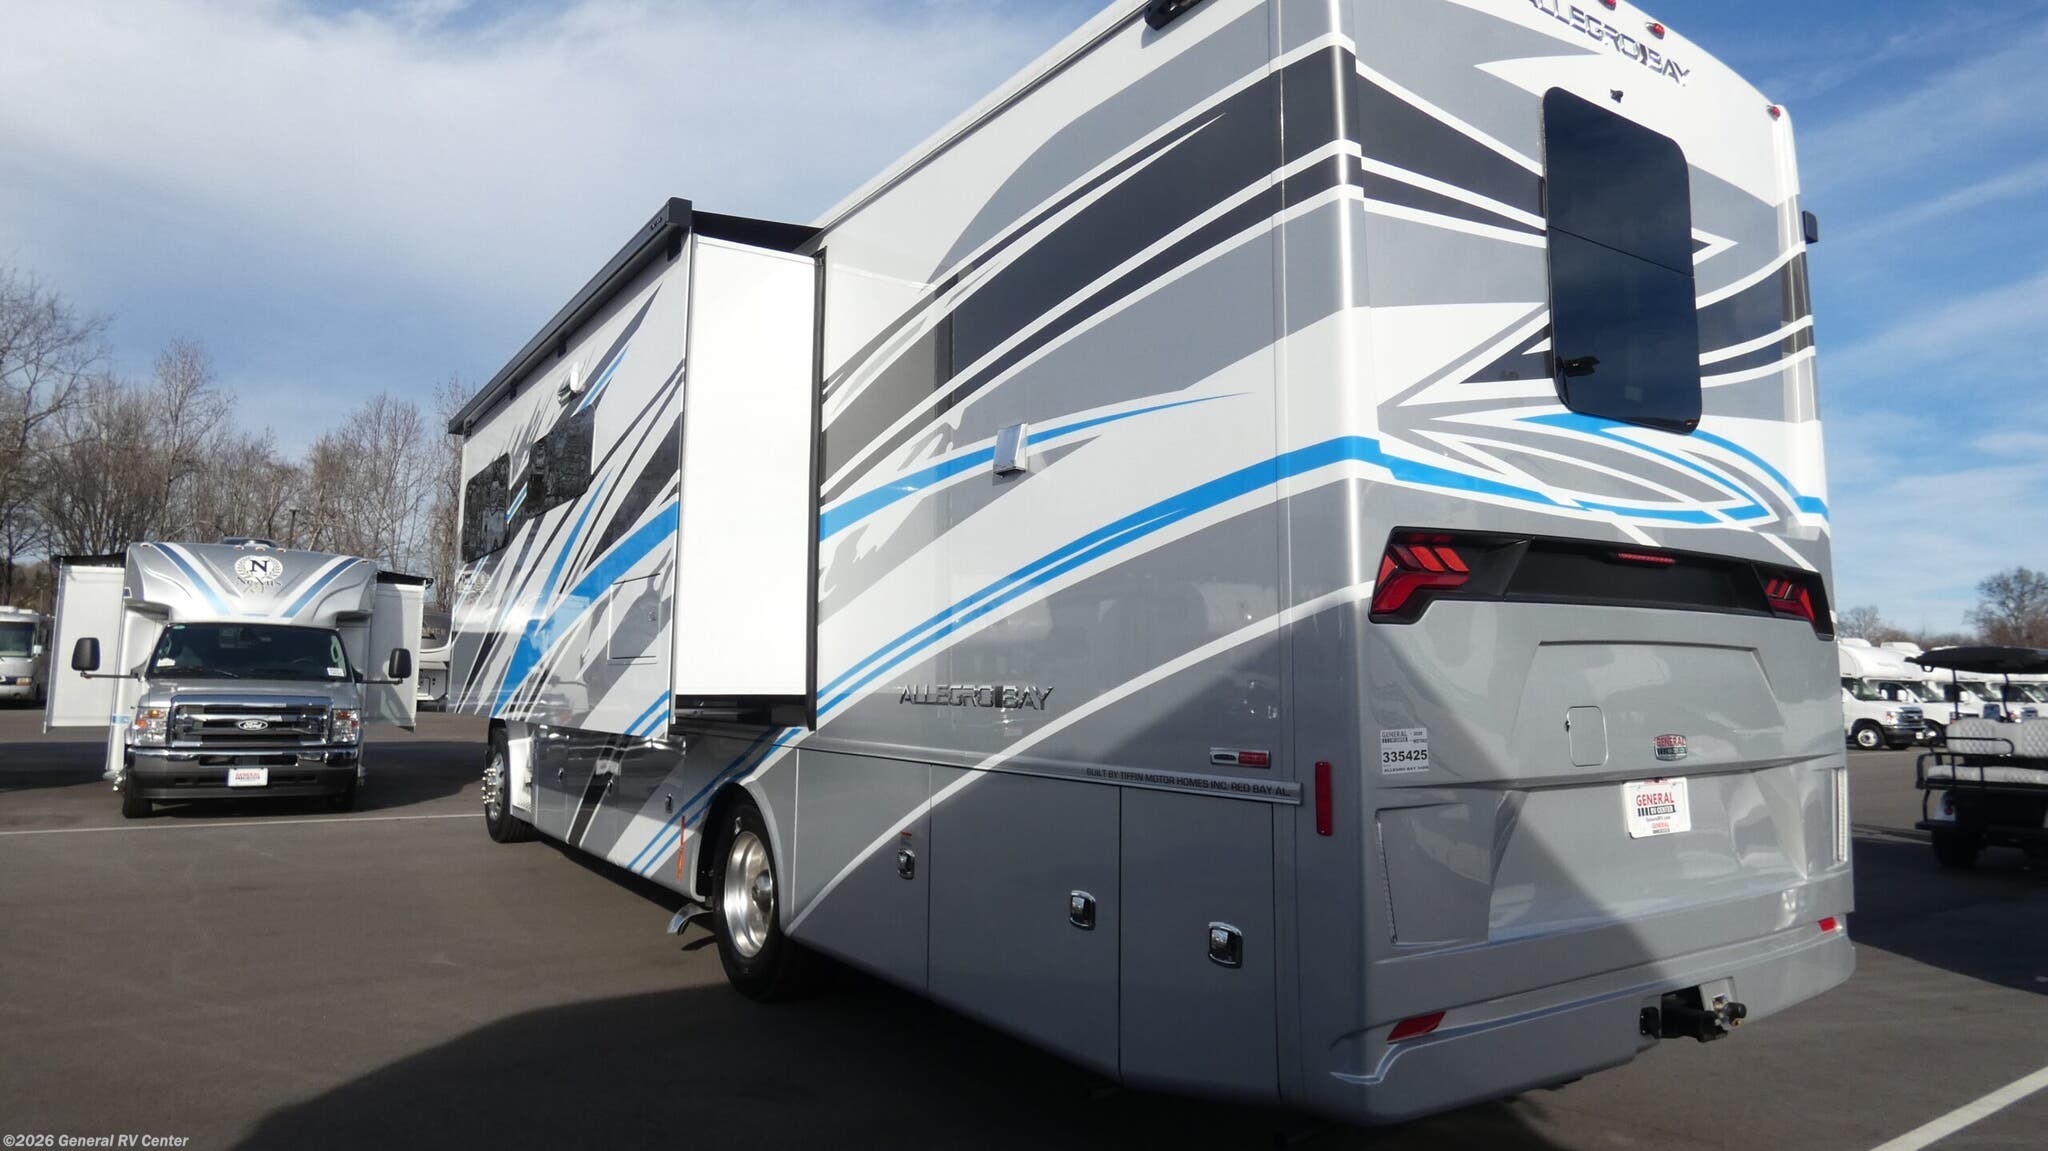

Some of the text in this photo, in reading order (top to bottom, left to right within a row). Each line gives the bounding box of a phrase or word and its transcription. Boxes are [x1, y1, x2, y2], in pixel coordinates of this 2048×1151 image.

[1647, 47, 1691, 84] BAY
[899, 684, 1055, 711] ALLEGRO BAY
[1383, 749, 1427, 763] 335425
[1086, 768, 1107, 778] BUILT
[1108, 770, 1118, 779] BY
[1120, 771, 1144, 782] TIFFIN
[1145, 773, 1175, 785] MOTOR
[1176, 777, 1209, 788] HOMES
[1231, 783, 1250, 793] RED
[1252, 784, 1272, 794] BAY
[1636, 792, 1674, 806] GENERAL
